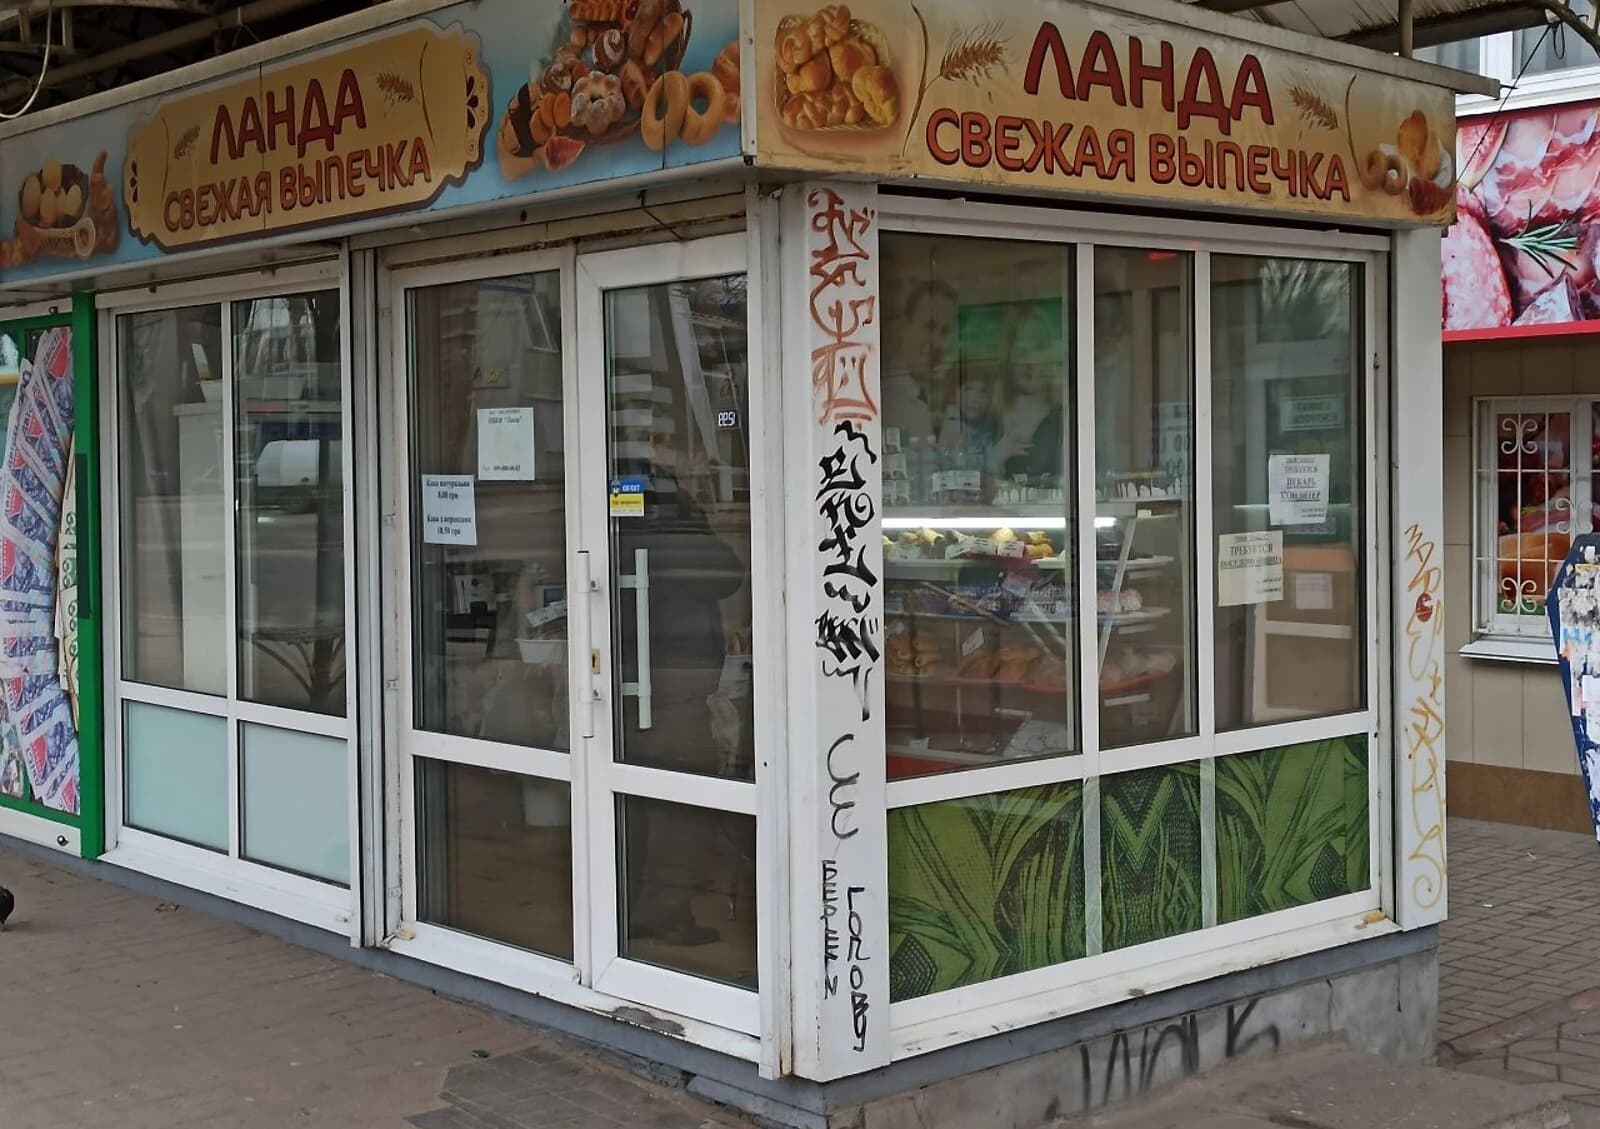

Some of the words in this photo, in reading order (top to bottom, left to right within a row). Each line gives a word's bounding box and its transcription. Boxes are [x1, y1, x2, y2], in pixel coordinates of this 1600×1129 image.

[209, 69, 367, 165] ЛАНДА
[1023, 21, 1275, 136] ЛАНДА
[164, 171, 272, 233] СВЕЖАЯ
[279, 137, 431, 211] ВЫПЕЧКА
[926, 107, 1136, 182] СВЕЖАЯ
[1149, 133, 1351, 202] ВЫПЕЧКА
